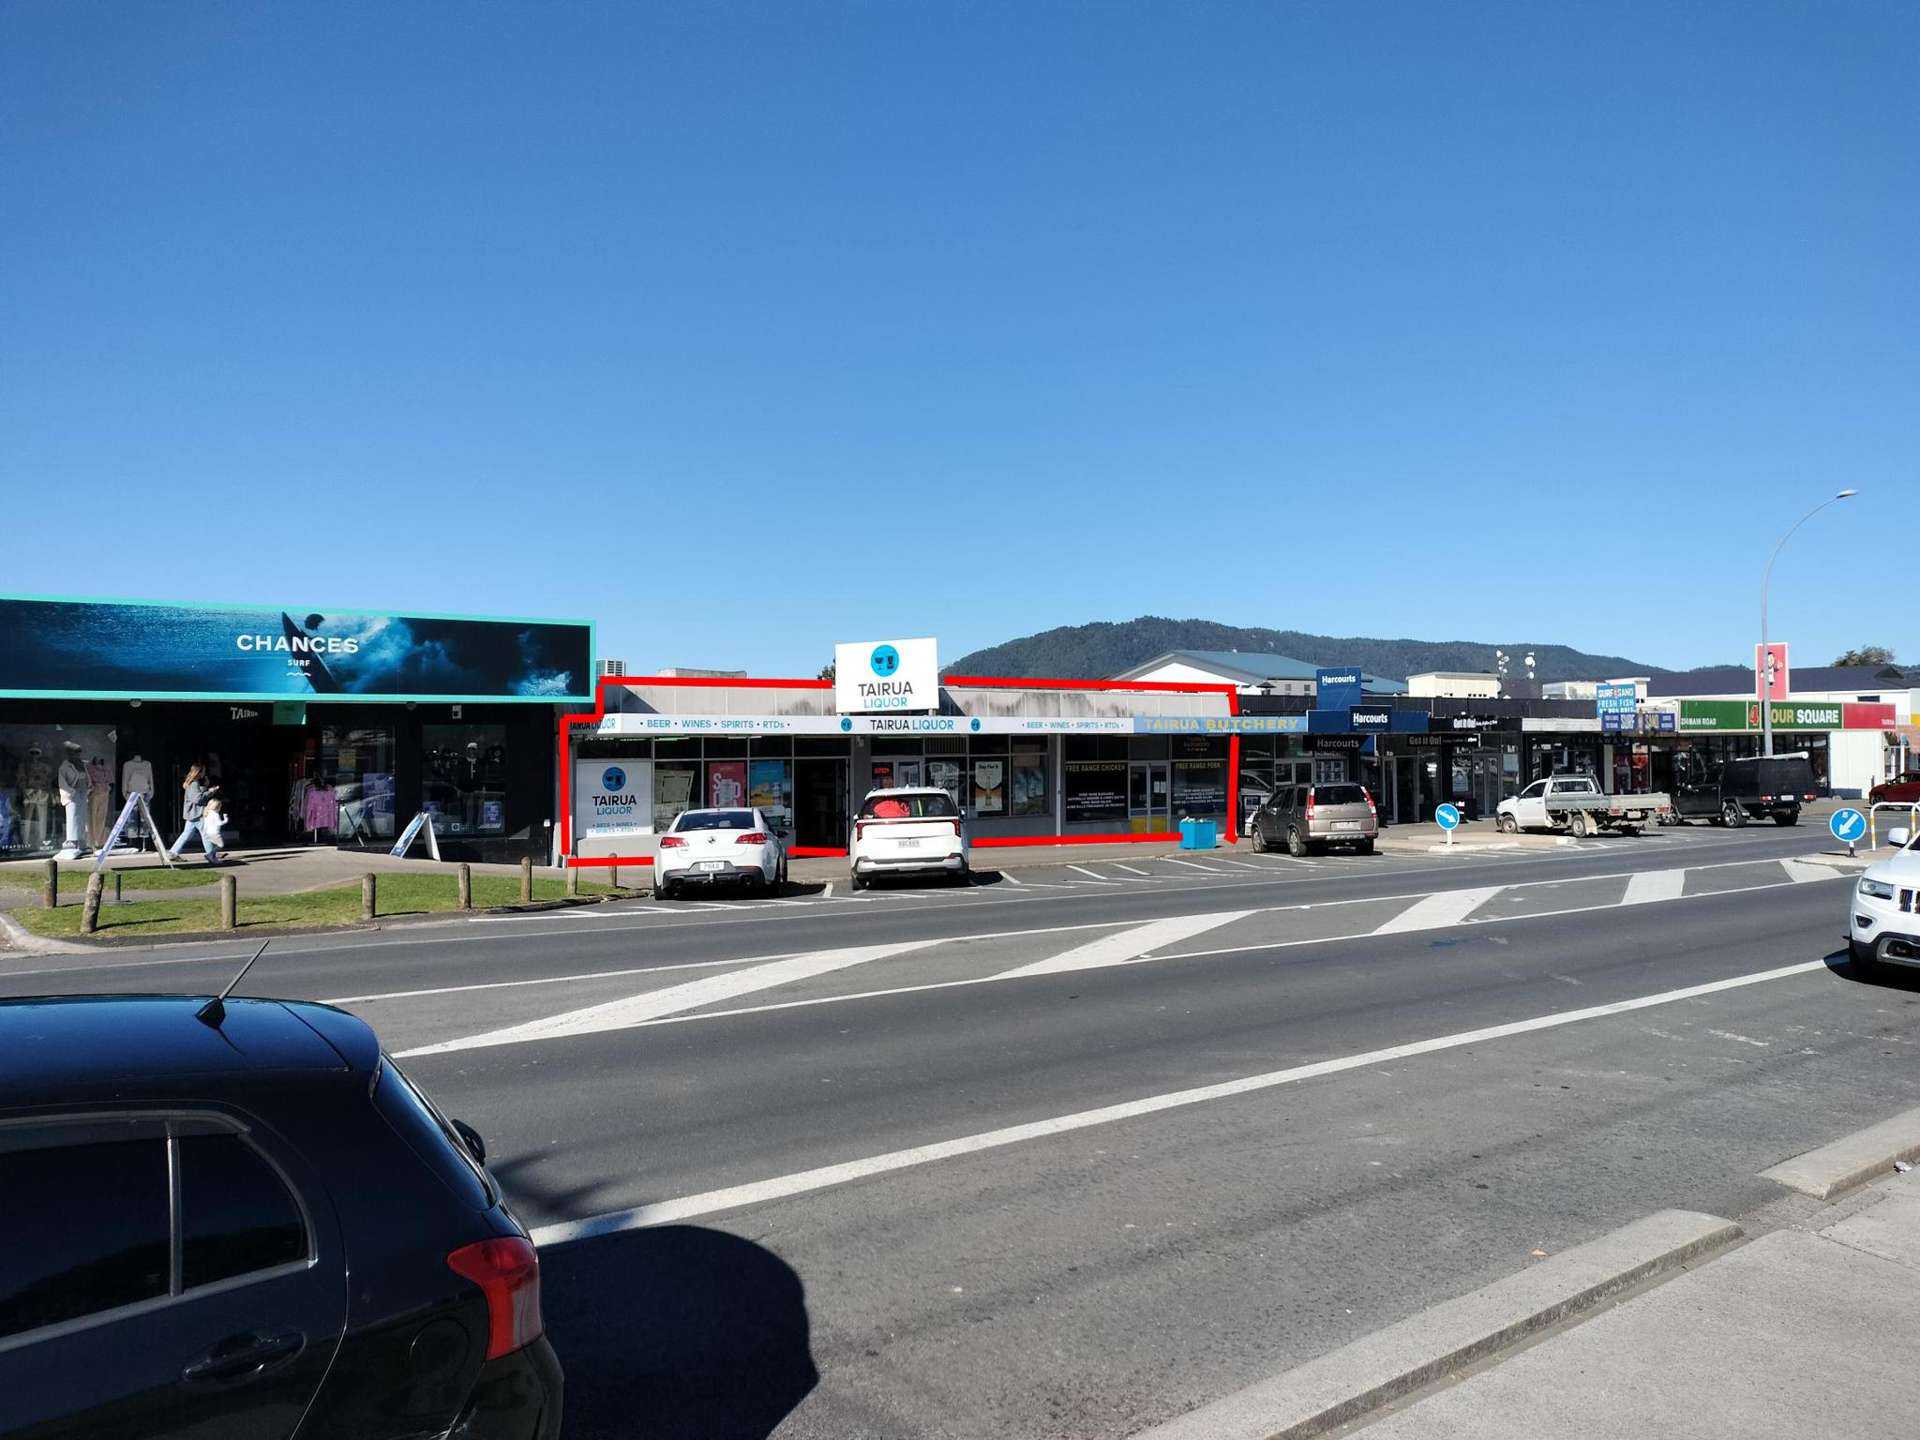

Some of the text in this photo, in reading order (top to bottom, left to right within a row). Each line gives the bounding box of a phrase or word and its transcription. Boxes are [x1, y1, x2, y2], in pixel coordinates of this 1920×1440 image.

[236, 634, 359, 654] CHANCES
[287, 659, 311, 667] SURF
[1322, 675, 1356, 683] Harcourts
[858, 681, 913, 697] TAIRUA
[864, 697, 908, 709] LIQUOR
[1353, 713, 1388, 724] Harcourts
[1771, 708, 1839, 724] OUR SQUARE
[647, 719, 785, 729] BEER WINES SPIRITS RTDs
[870, 719, 954, 731] TAIRUA LIQUOR
[1026, 721, 1043, 729] BEER
[1144, 719, 1298, 730] TAIRUA BUTCHERY
[1702, 718, 1717, 726] ROAD
[1317, 739, 1360, 748] Harcourts
[592, 794, 637, 806] TAIRUA
[596, 806, 632, 816] LIQUOR
